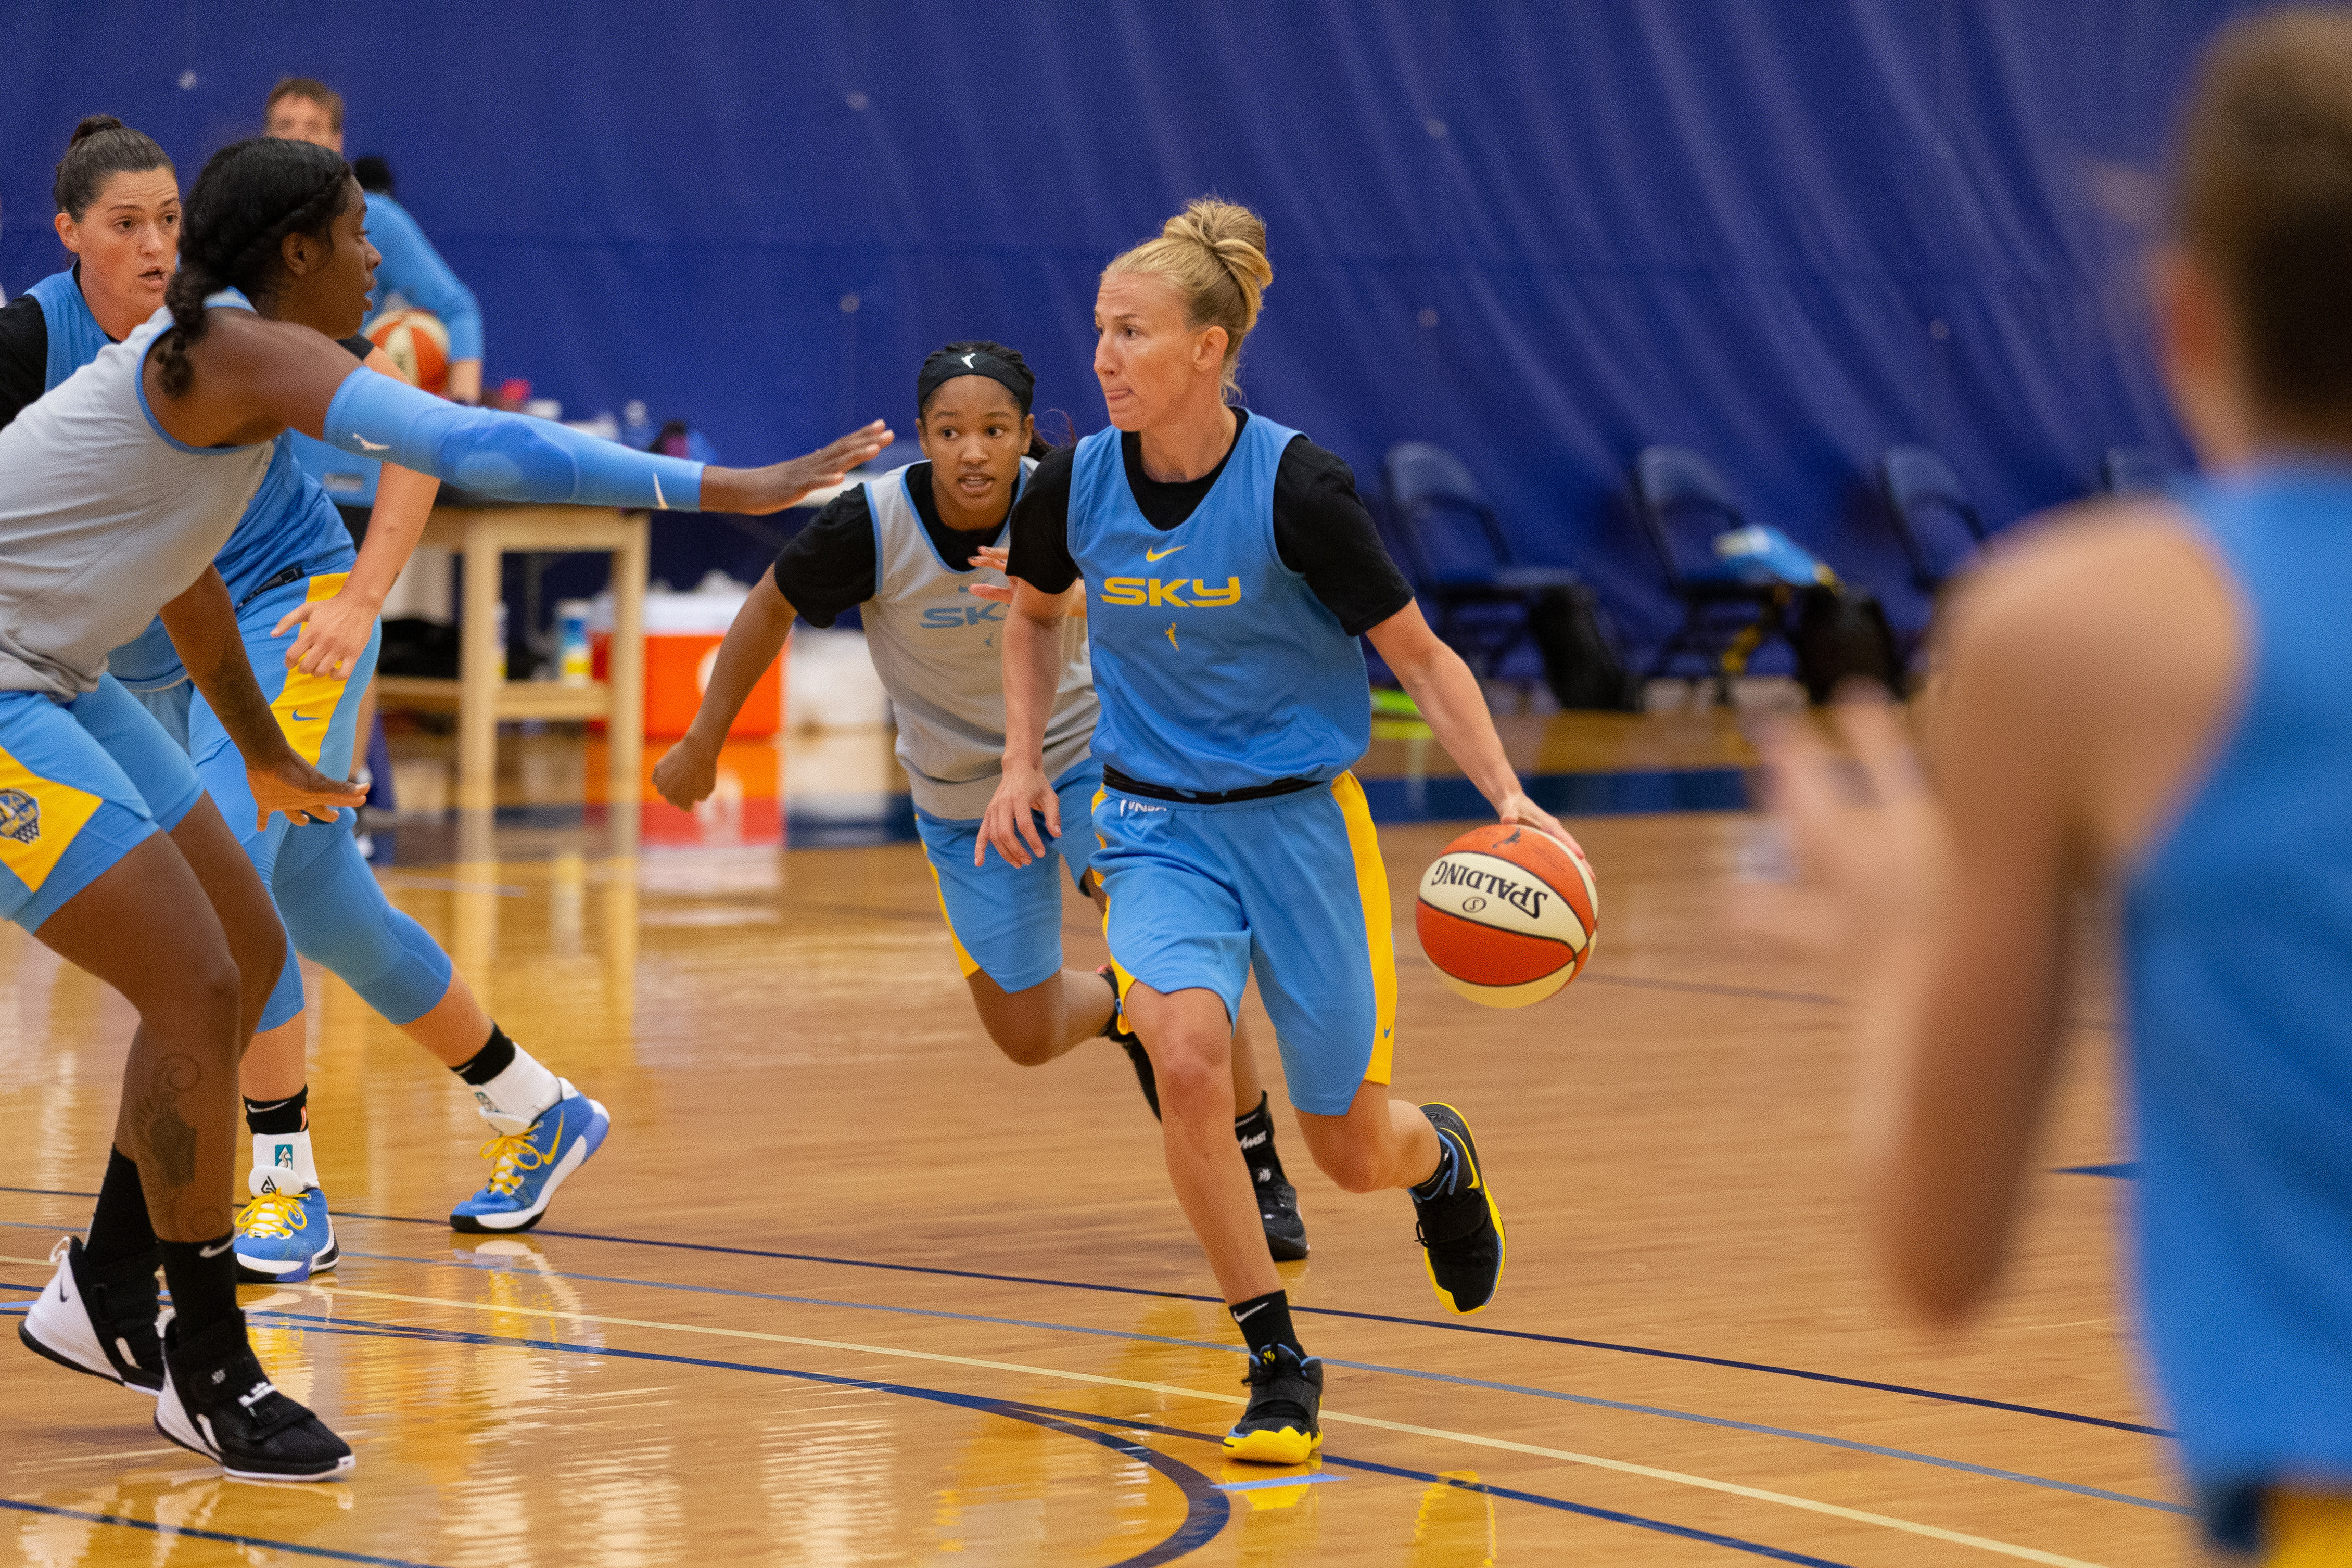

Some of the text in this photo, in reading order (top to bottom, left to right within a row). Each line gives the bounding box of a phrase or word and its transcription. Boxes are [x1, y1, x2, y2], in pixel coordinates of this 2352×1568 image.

[1100, 577, 1241, 608] SKY
[919, 602, 1010, 629] SK
[1431, 861, 1547, 919] SPALDING
